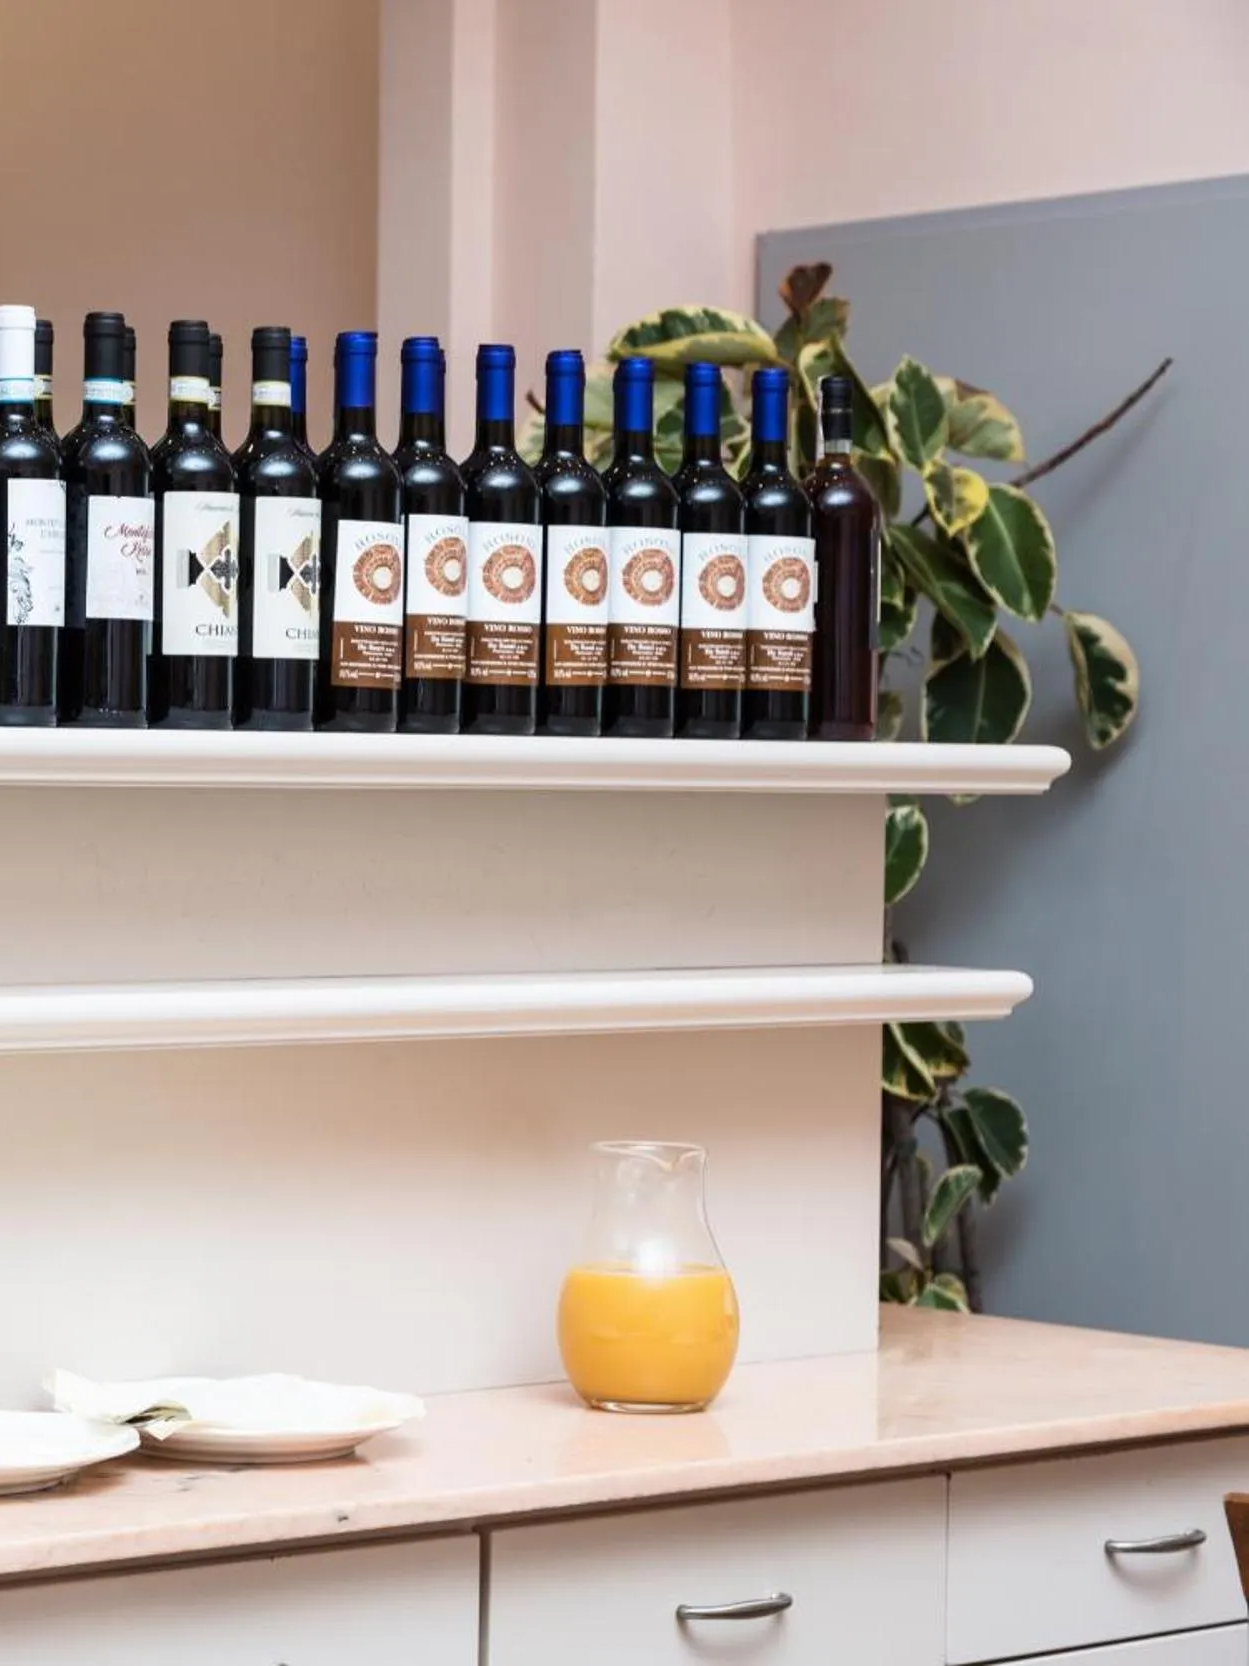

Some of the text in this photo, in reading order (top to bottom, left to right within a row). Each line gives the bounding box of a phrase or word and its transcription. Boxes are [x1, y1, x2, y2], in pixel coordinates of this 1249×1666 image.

[427, 617, 448, 626] VINO
[354, 624, 376, 634] VINO
[484, 624, 507, 633] VINO
[567, 626, 587, 635] VINO
[624, 626, 646, 635] VINO
[702, 631, 721, 639] VINO
[764, 632, 784, 640] VINO
